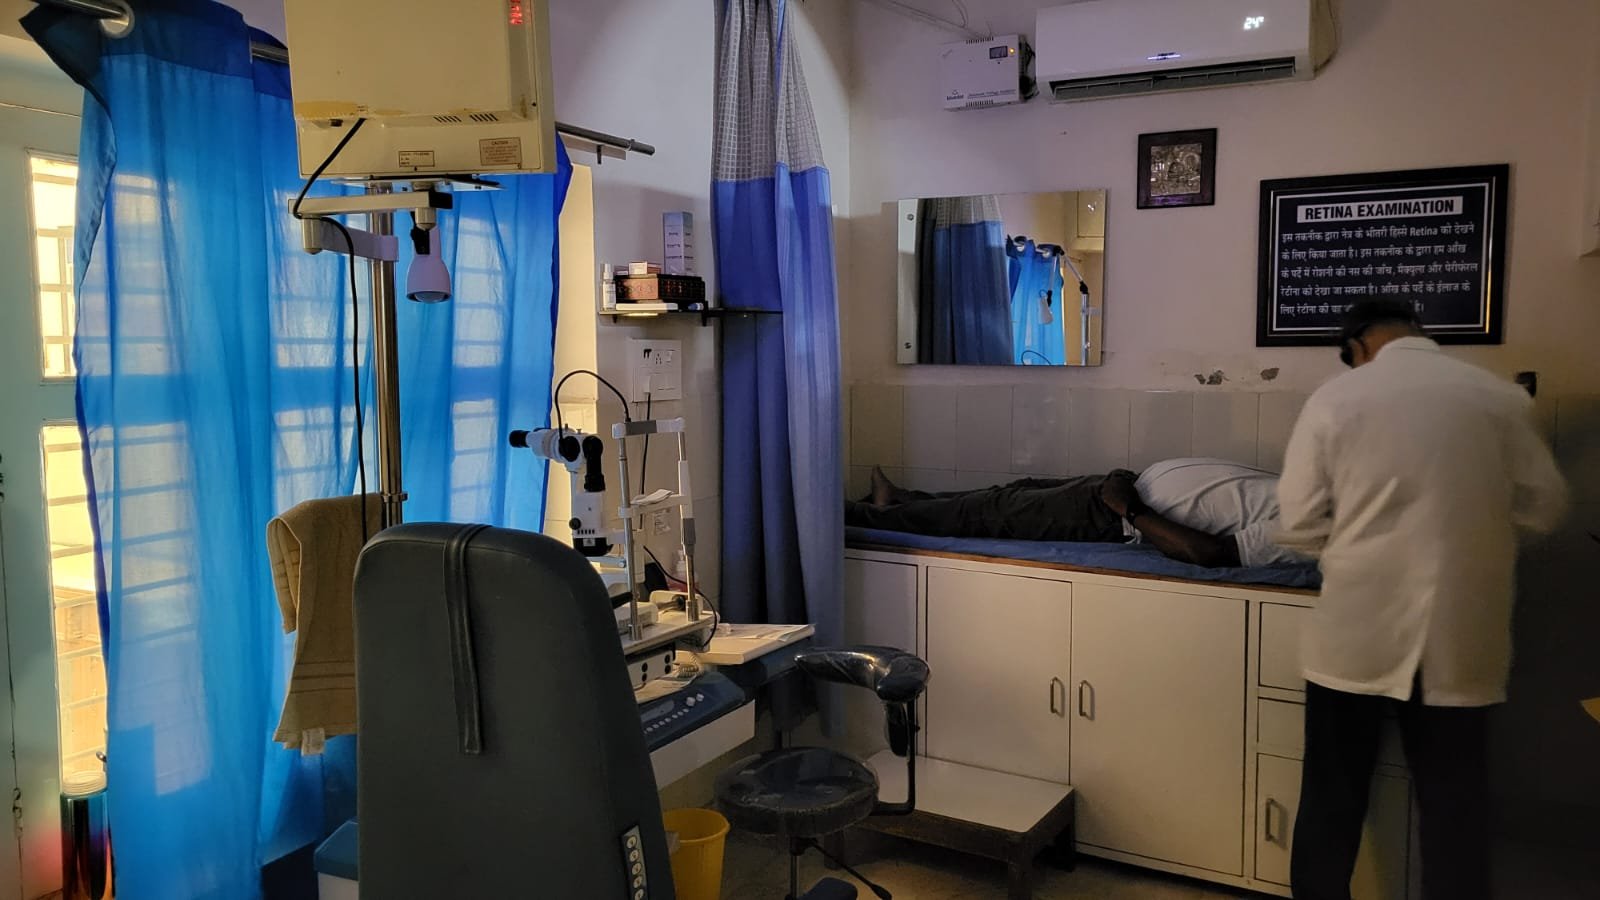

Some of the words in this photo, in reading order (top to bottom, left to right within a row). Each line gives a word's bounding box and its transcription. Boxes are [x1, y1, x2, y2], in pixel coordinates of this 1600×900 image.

[1304, 205, 1353, 220] RETINA
[1357, 199, 1454, 217] EXAMINATION
[1282, 233, 1293, 243] इस
[1295, 229, 1323, 240] तकनीक
[1324, 231, 1339, 242] द्वारा
[1341, 227, 1353, 239] नेत्र
[1355, 227, 1363, 239] के
[1366, 226, 1387, 238] भीतरी
[1390, 224, 1408, 238] हिस्से
[1410, 226, 1438, 237] Retina
[1440, 222, 1452, 235] को
[1454, 221, 1474, 235] देखने
[1281, 248, 1290, 260] के
[1292, 249, 1307, 262] लिए
[1309, 248, 1327, 259] किया
[1329, 249, 1346, 258] जाता
[1360, 248, 1372, 258] इस
[1374, 244, 1403, 256] तकनीक
[1405, 243, 1414, 255] के
[1416, 246, 1431, 256] द्वारा
[1281, 267, 1289, 278] के
[1312, 265, 1333, 277] रोशनी
[1428, 260, 1443, 273] और
[1302, 284, 1313, 295] को
[1315, 284, 1330, 296] देखा
[1344, 286, 1366, 294] सकता
[1401, 281, 1410, 292] के
[1426, 280, 1435, 292] के
[1280, 303, 1295, 317] लिए
